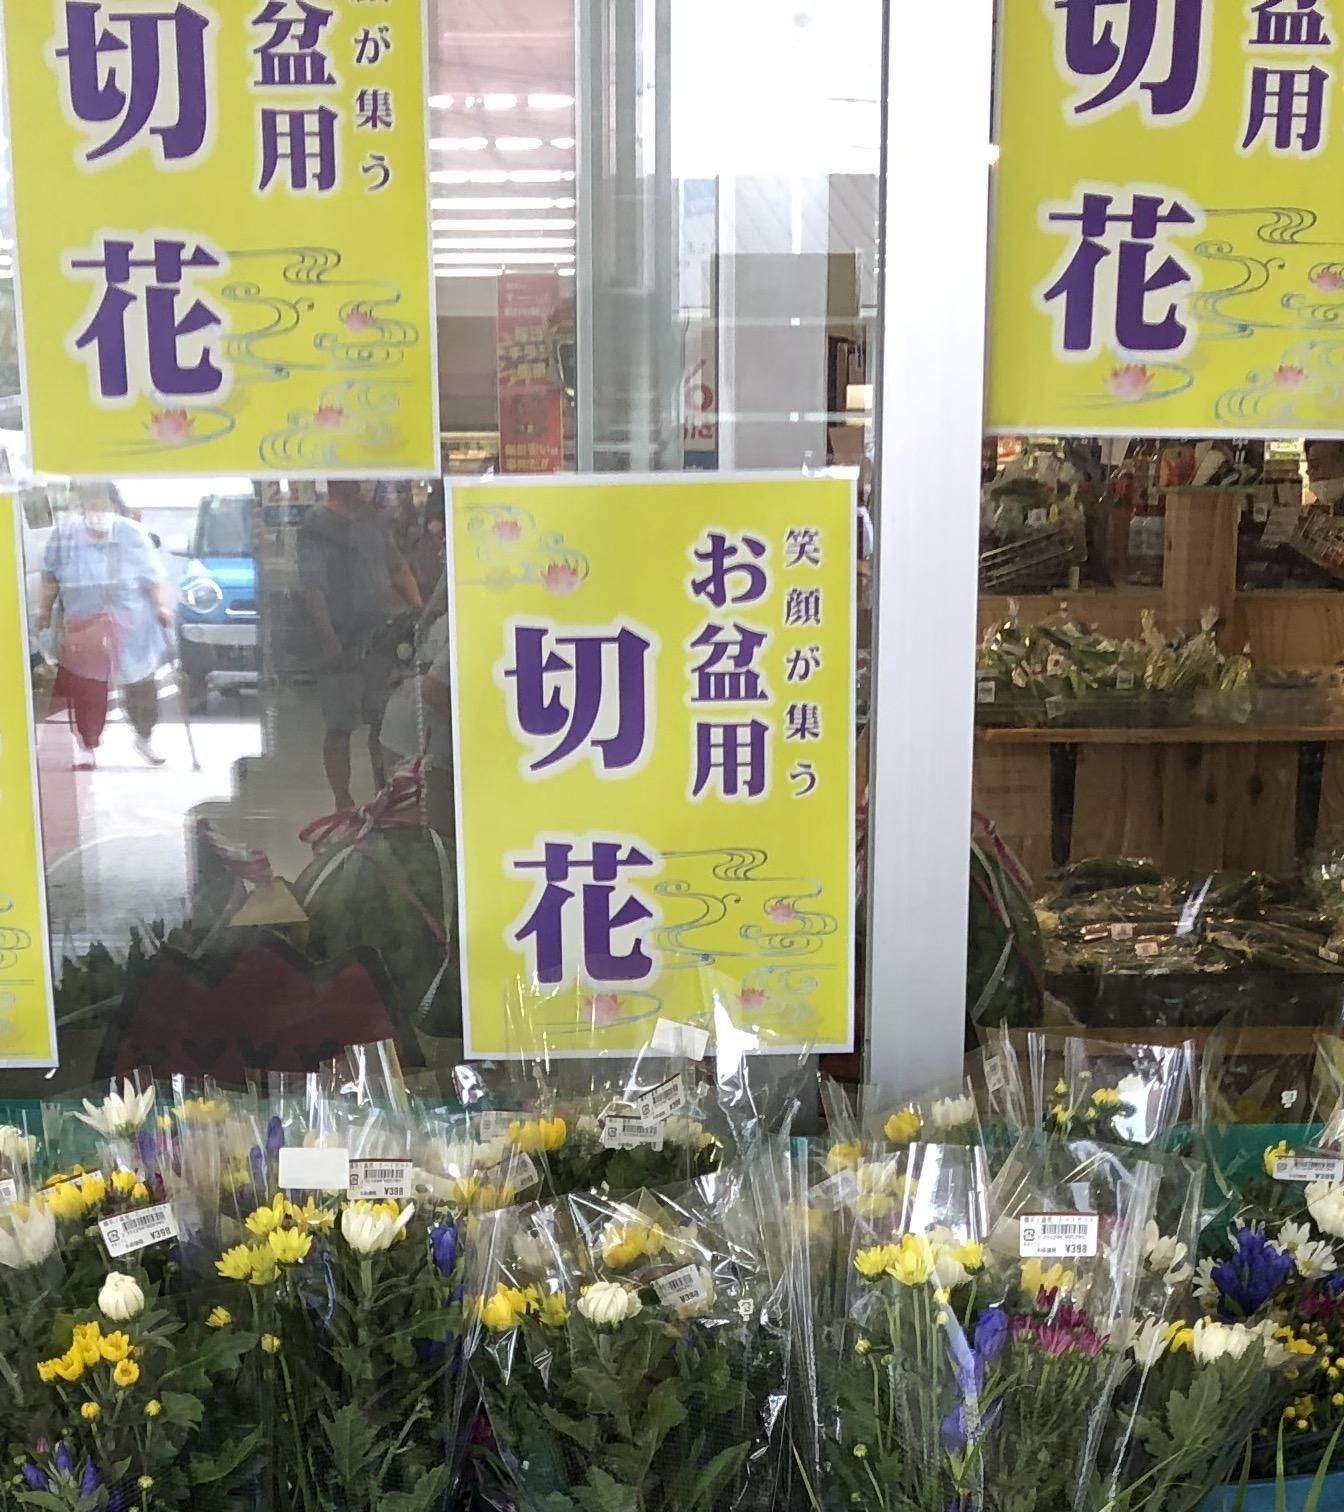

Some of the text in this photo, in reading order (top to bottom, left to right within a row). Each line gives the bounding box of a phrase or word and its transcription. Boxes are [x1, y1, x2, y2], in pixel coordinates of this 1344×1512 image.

[56, 1, 223, 397] 切花
[353, 0, 394, 191] が集う
[690, 531, 770, 798] お盆用
[782, 527, 822, 797] 笑顔が集う
[504, 625, 655, 984] 切花
[150, 1226, 172, 1240] ¥398
[384, 1186, 404, 1197] ¥398
[1065, 1244, 1088, 1255] ¥398
